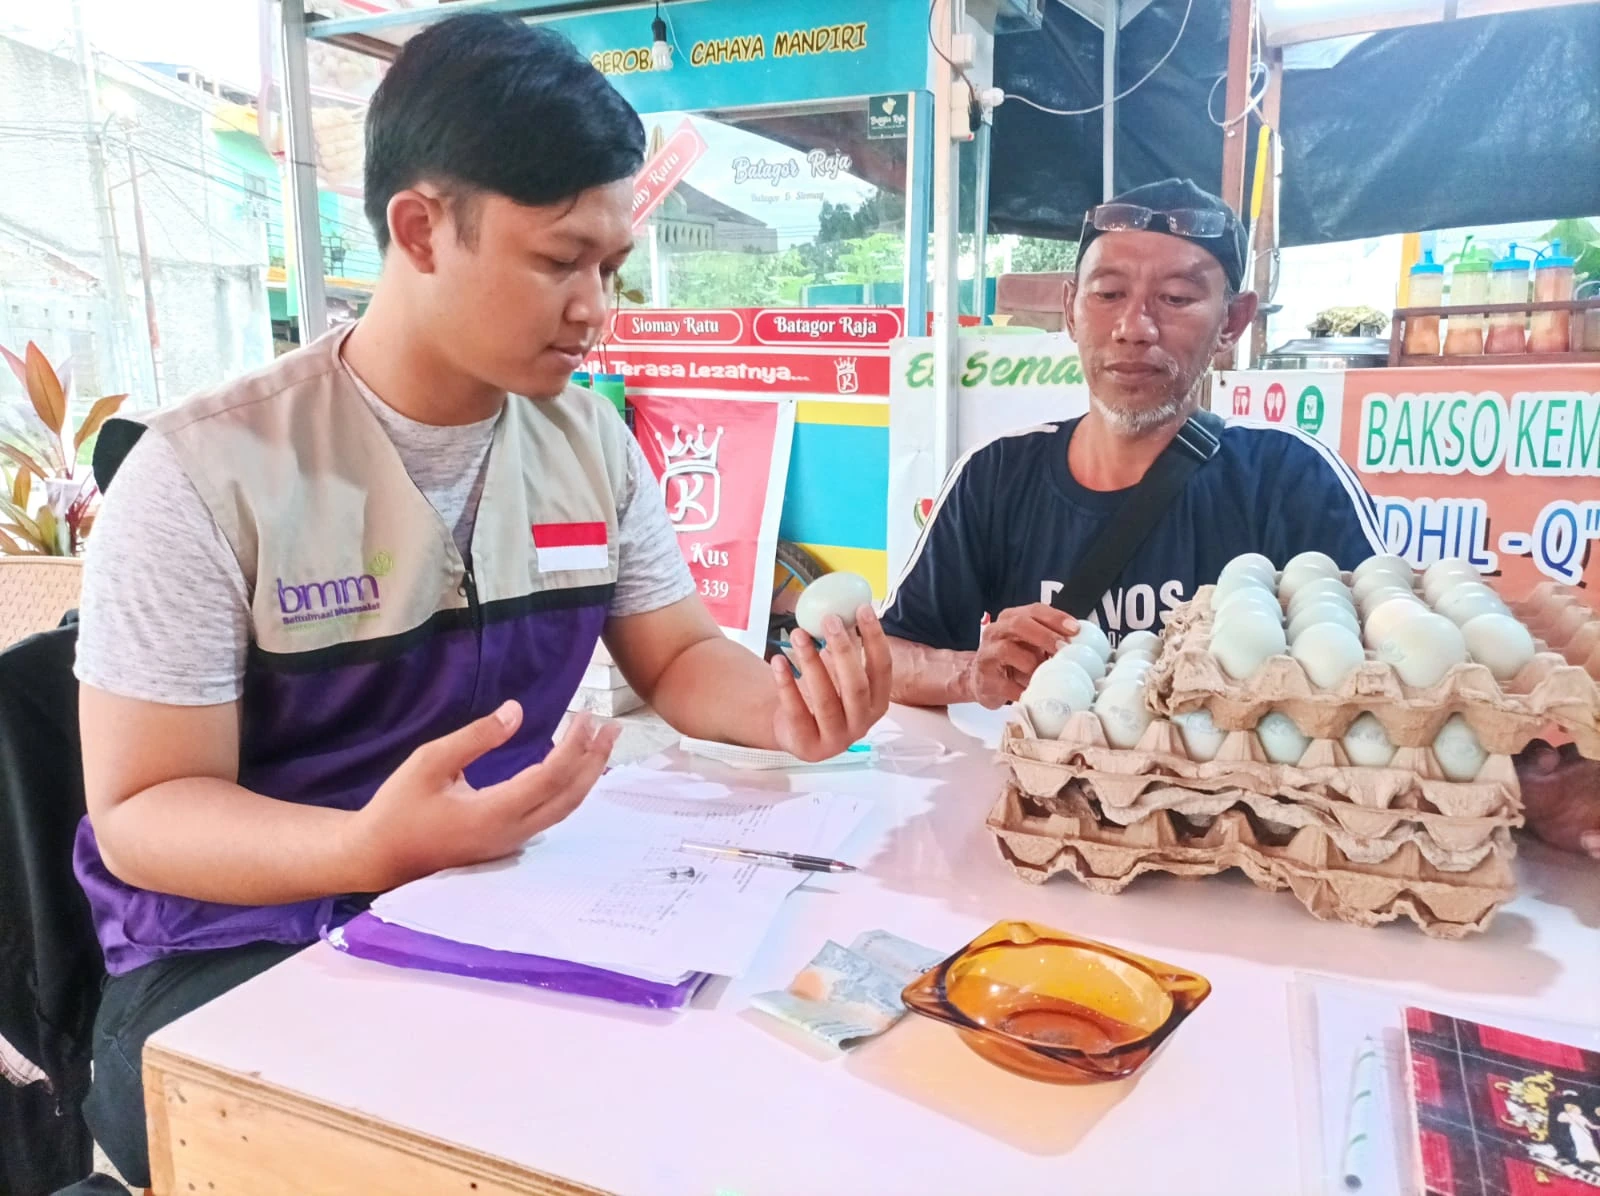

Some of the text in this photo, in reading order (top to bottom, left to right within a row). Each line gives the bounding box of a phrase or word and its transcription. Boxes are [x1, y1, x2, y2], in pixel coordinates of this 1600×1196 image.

[591, 23, 867, 74] GEROB CAHAYA MANDIRI
[649, 152, 679, 186] Ratu
[732, 148, 853, 187] Batagor Raja
[631, 317, 720, 336] Siomay Ratu
[773, 316, 878, 338] Batagor Raja
[610, 360, 686, 377] Terasa
[1365, 399, 1600, 468] BAKSO KEM
[1374, 503, 1489, 566] DHIL
[691, 543, 729, 568] Kus
[276, 574, 379, 614] bmm
[700, 579, 729, 598] 339
